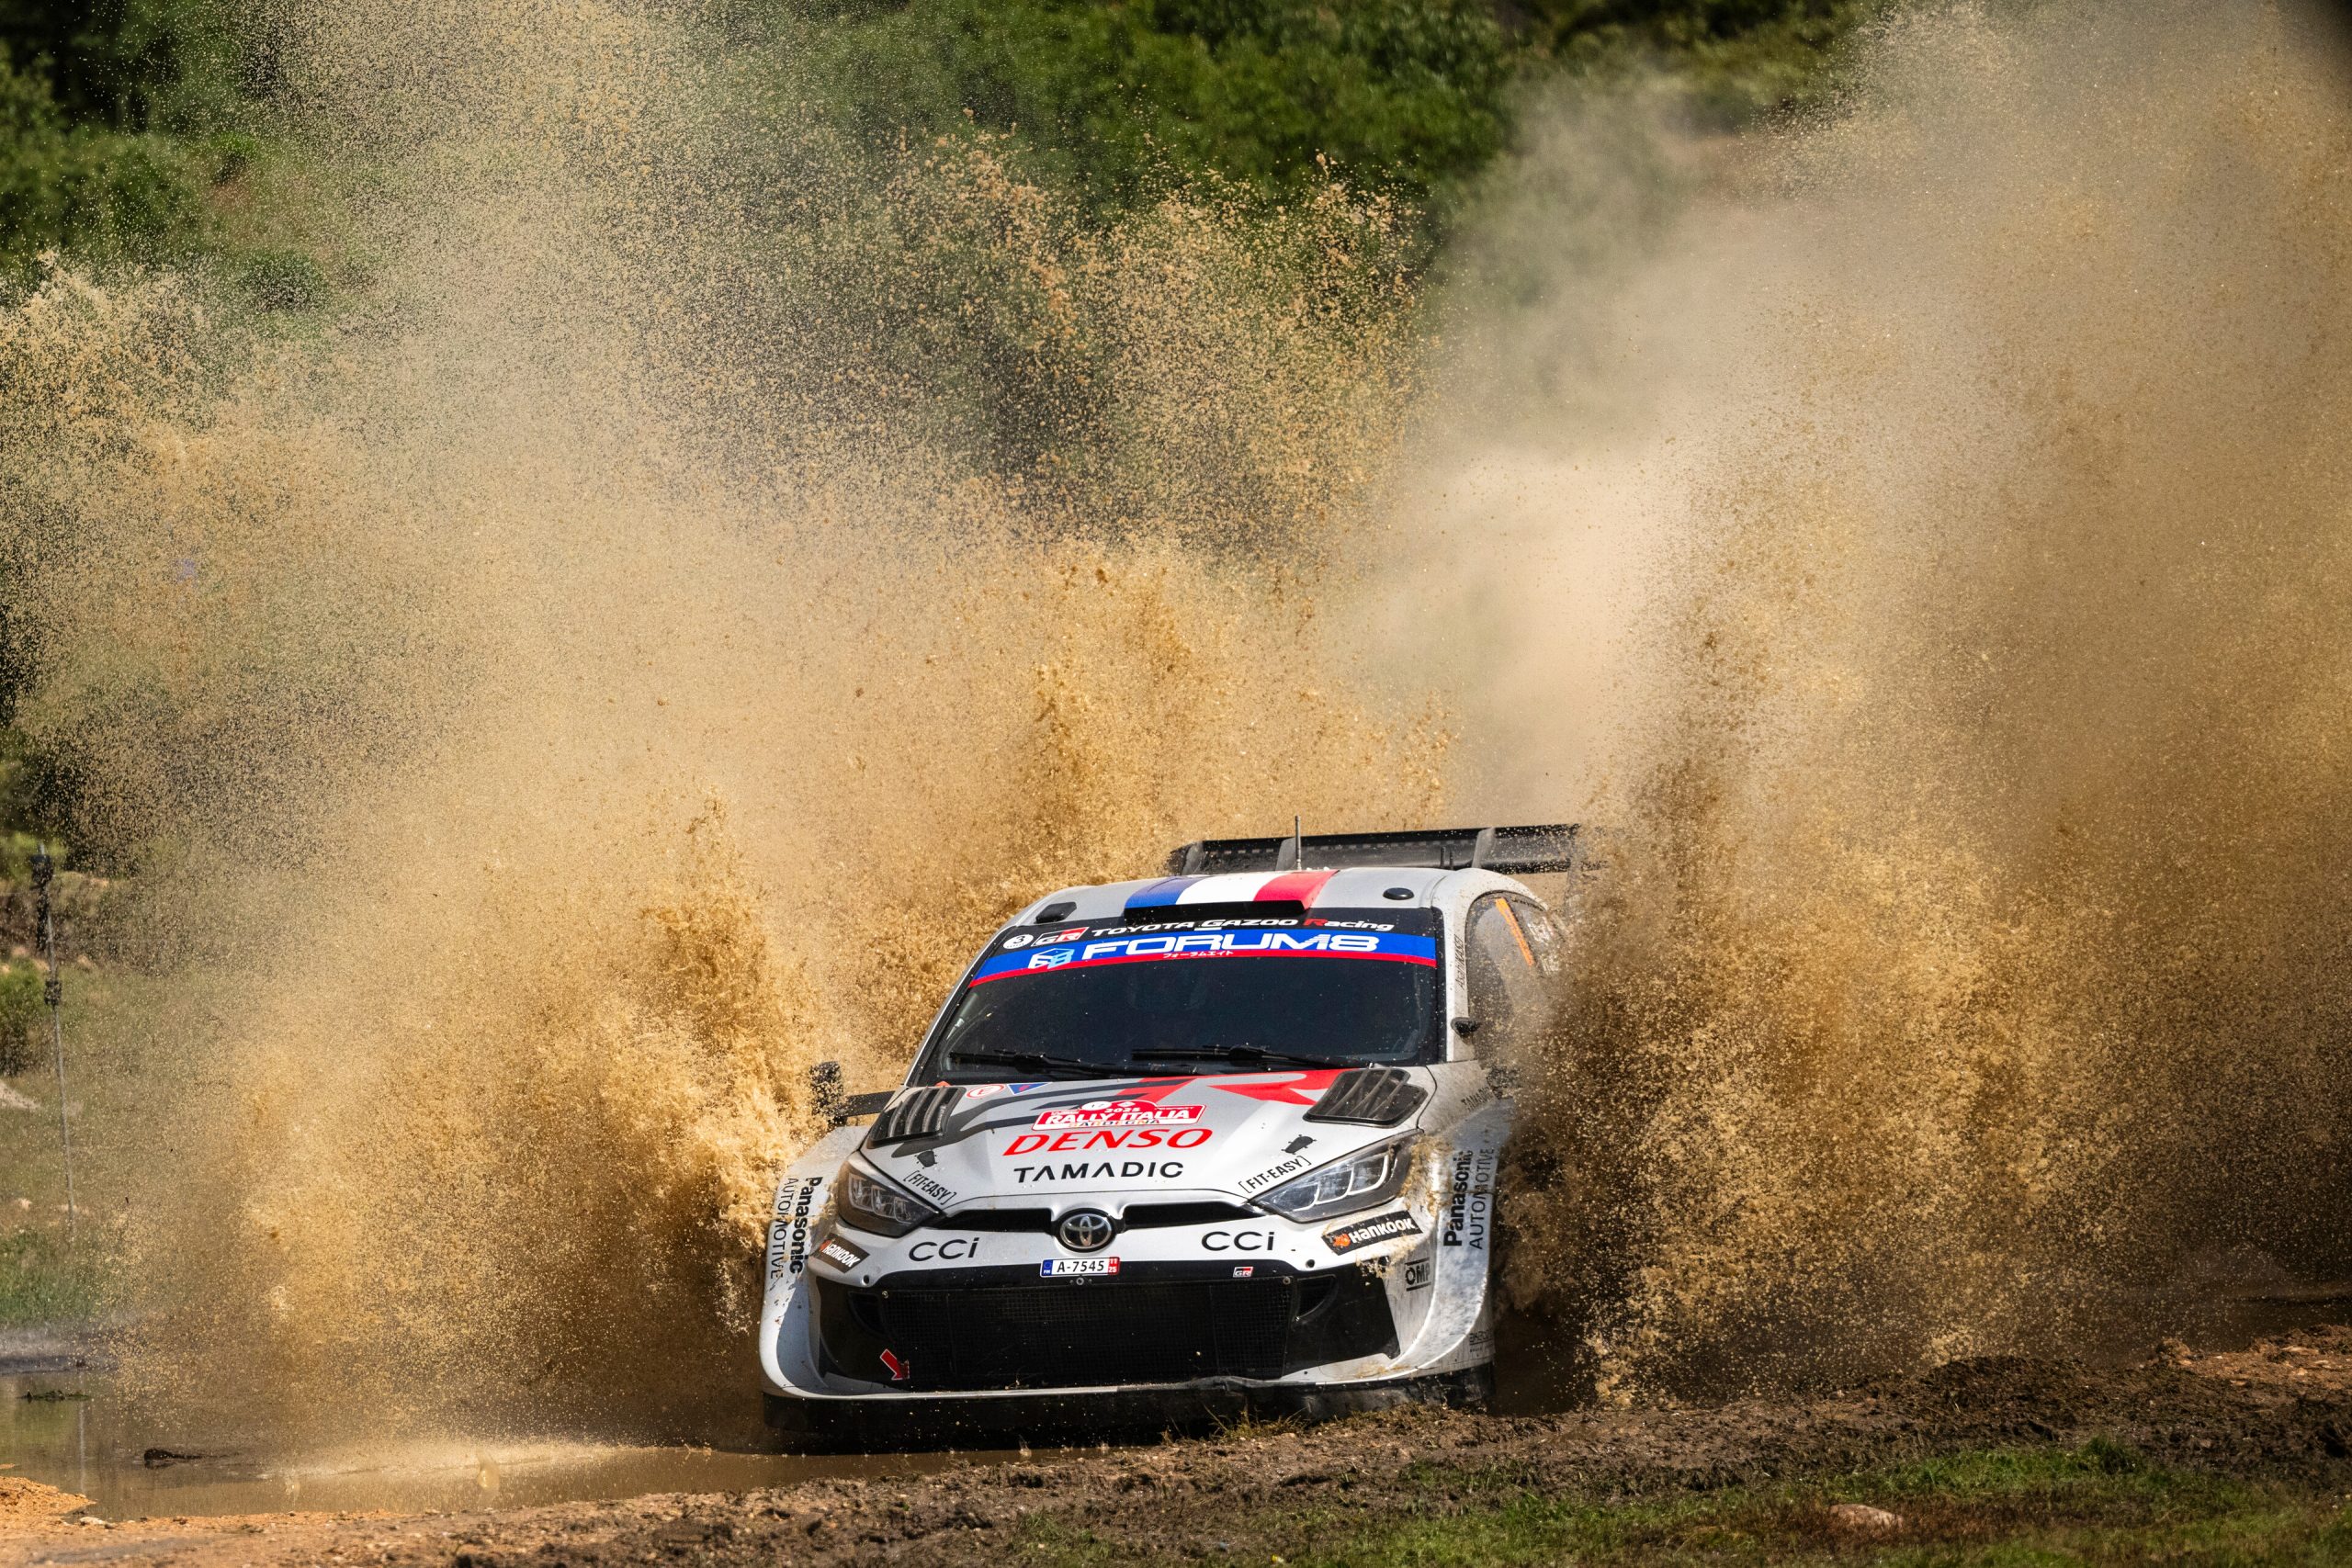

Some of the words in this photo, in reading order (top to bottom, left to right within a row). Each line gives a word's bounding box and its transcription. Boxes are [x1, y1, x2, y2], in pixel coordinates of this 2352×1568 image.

[1091, 921, 1194, 937] TOYOTA
[1201, 919, 1298, 928] GAZOO
[1304, 919, 1395, 931] Racing
[1081, 933, 1379, 961] FORUM8
[1046, 1112, 1115, 1124] RALLY
[1119, 1110, 1190, 1121] ITALIA
[1003, 1128, 1213, 1156] DENSO
[1014, 1161, 1184, 1183] TAMADIC
[1443, 1150, 1474, 1247] Panasonic
[1469, 1148, 1494, 1250] AUTOMOTIVE
[771, 1178, 799, 1279] AUTOMOTIVE
[790, 1177, 823, 1274] Panasonic
[1057, 1261, 1104, 1273] A-7545
